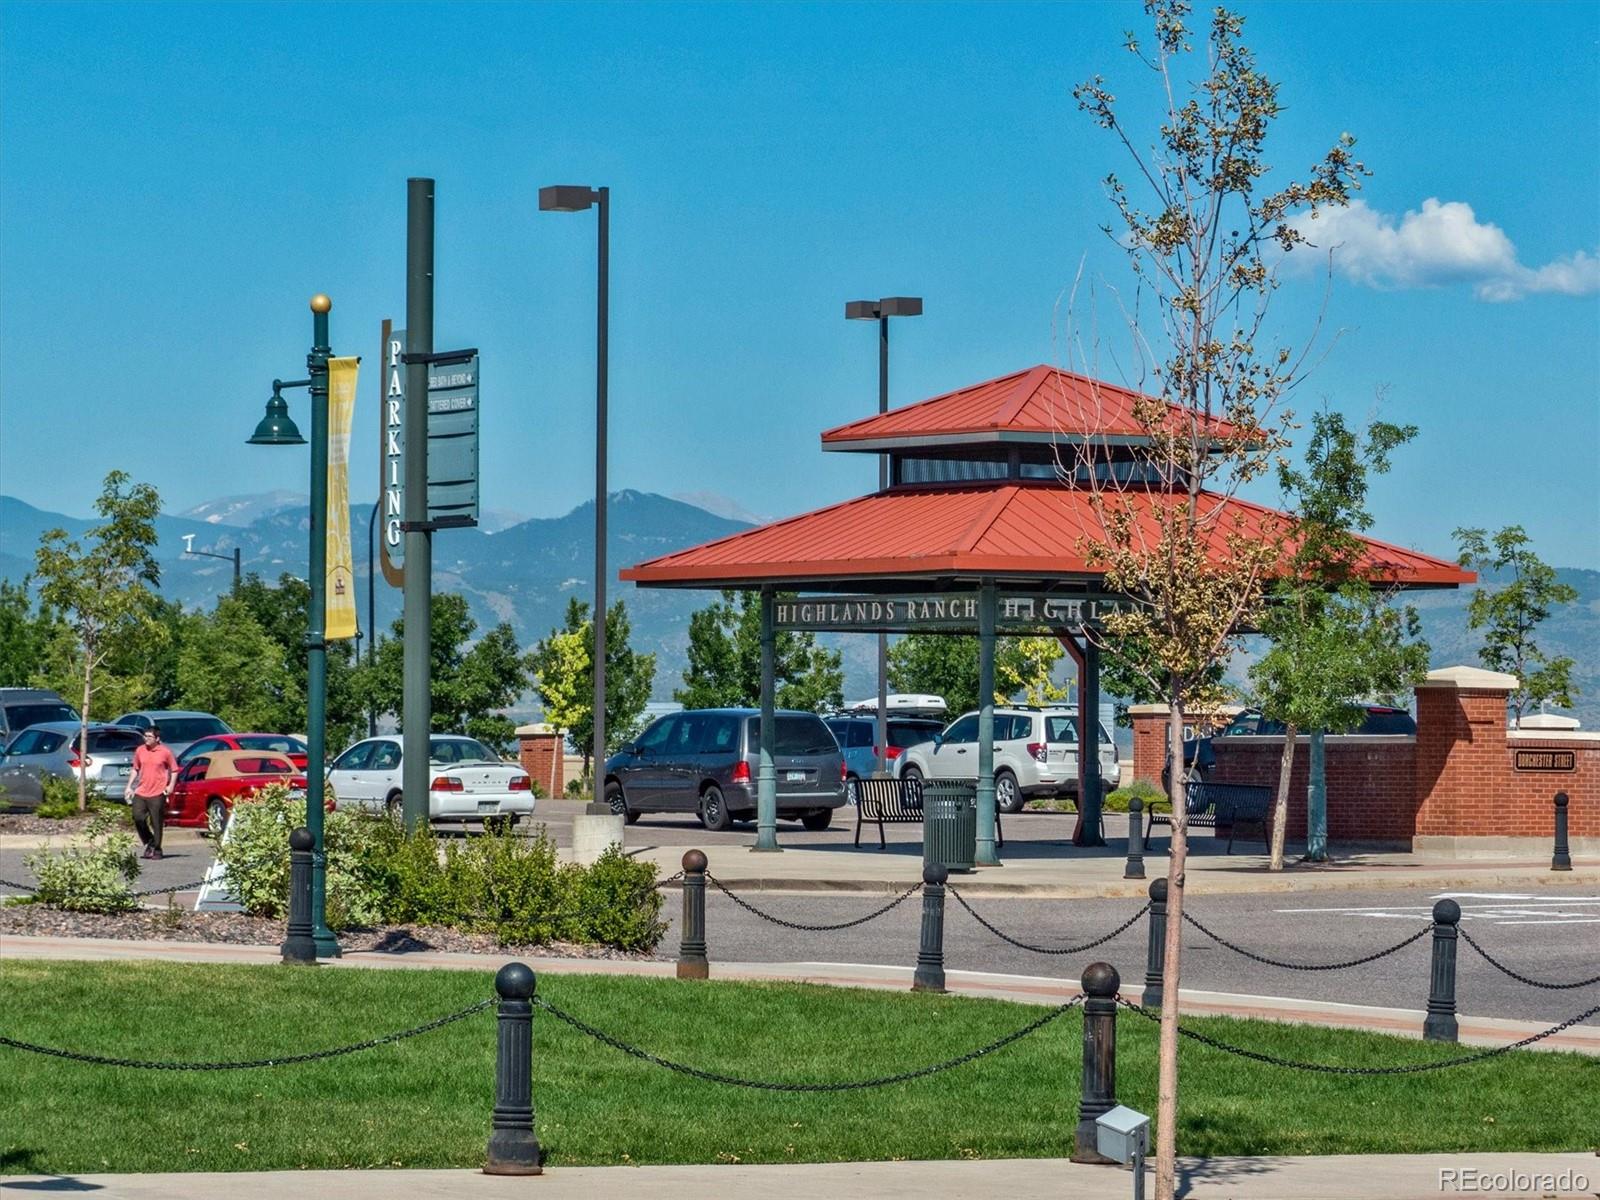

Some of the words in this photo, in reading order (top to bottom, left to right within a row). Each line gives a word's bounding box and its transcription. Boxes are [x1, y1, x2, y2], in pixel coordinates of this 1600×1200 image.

[387, 341, 401, 545] PARKING
[777, 602, 895, 622] HIGHLANDS
[908, 599, 976, 619] RANCH
[1004, 600, 1167, 619] HIGHLAN
[1554, 753, 1573, 768] STREET
